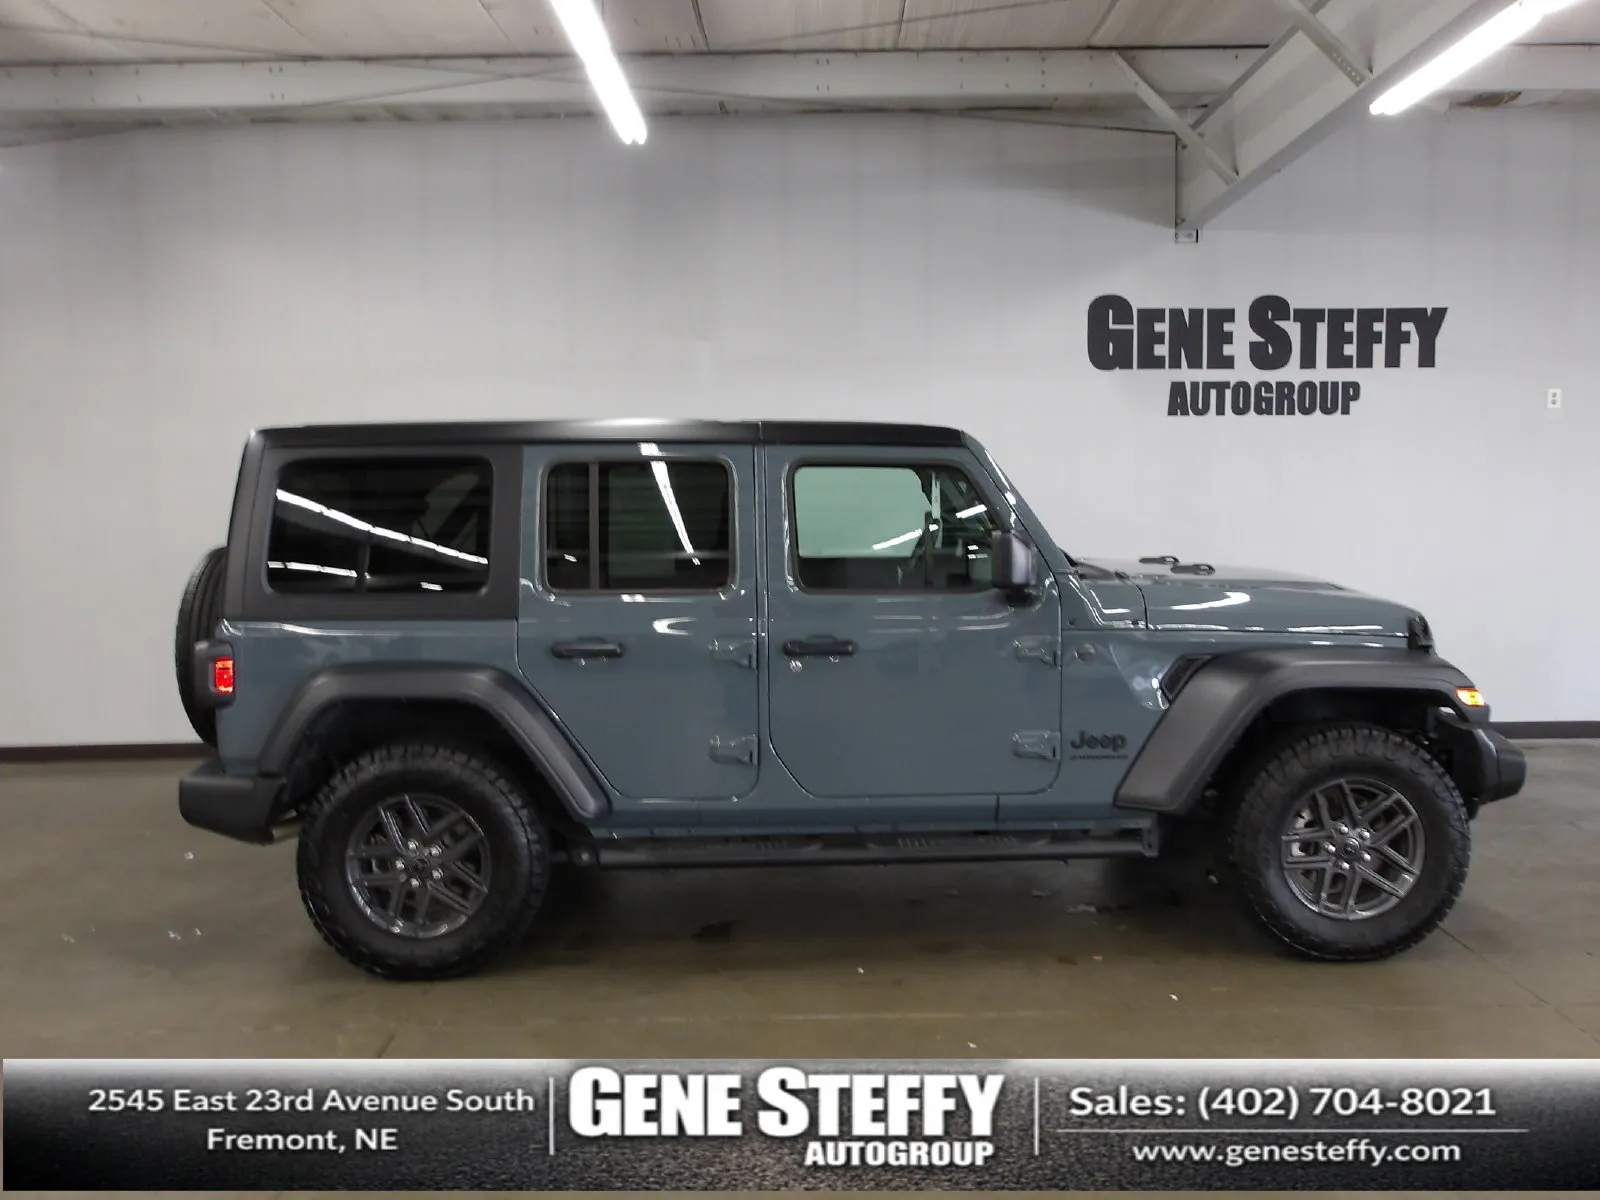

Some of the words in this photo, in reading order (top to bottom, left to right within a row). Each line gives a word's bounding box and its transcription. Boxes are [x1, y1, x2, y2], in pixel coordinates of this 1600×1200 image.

[1087, 294, 1235, 370] GENE
[1248, 294, 1448, 370] STEFFY
[1167, 381, 1360, 416] AUTOGROUP
[1070, 730, 1127, 752] Jeep
